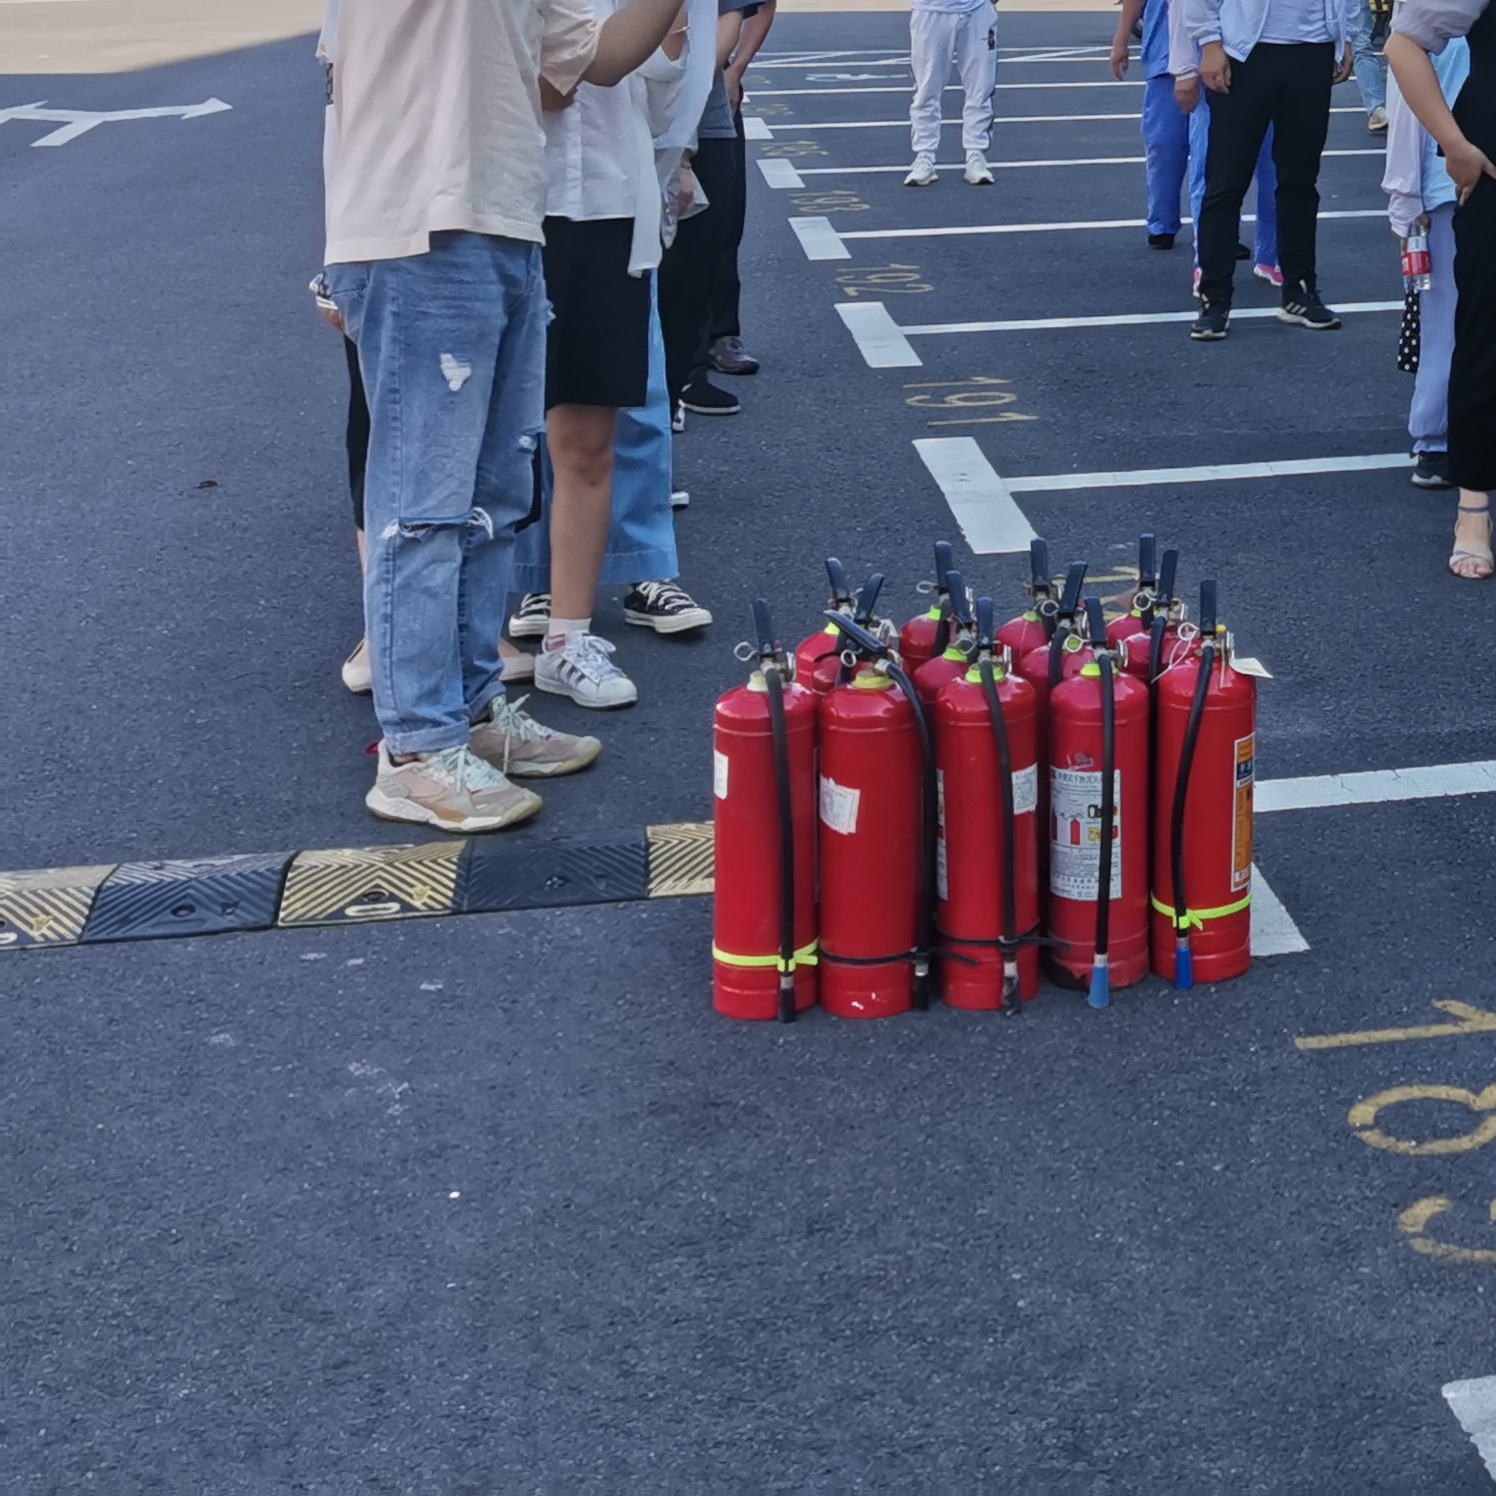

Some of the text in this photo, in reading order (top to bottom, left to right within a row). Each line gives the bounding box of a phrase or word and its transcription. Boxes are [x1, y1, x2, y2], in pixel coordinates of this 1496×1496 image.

[787, 190, 871, 213] 193
[835, 263, 934, 296] 192
[902, 376, 1039, 427] 191
